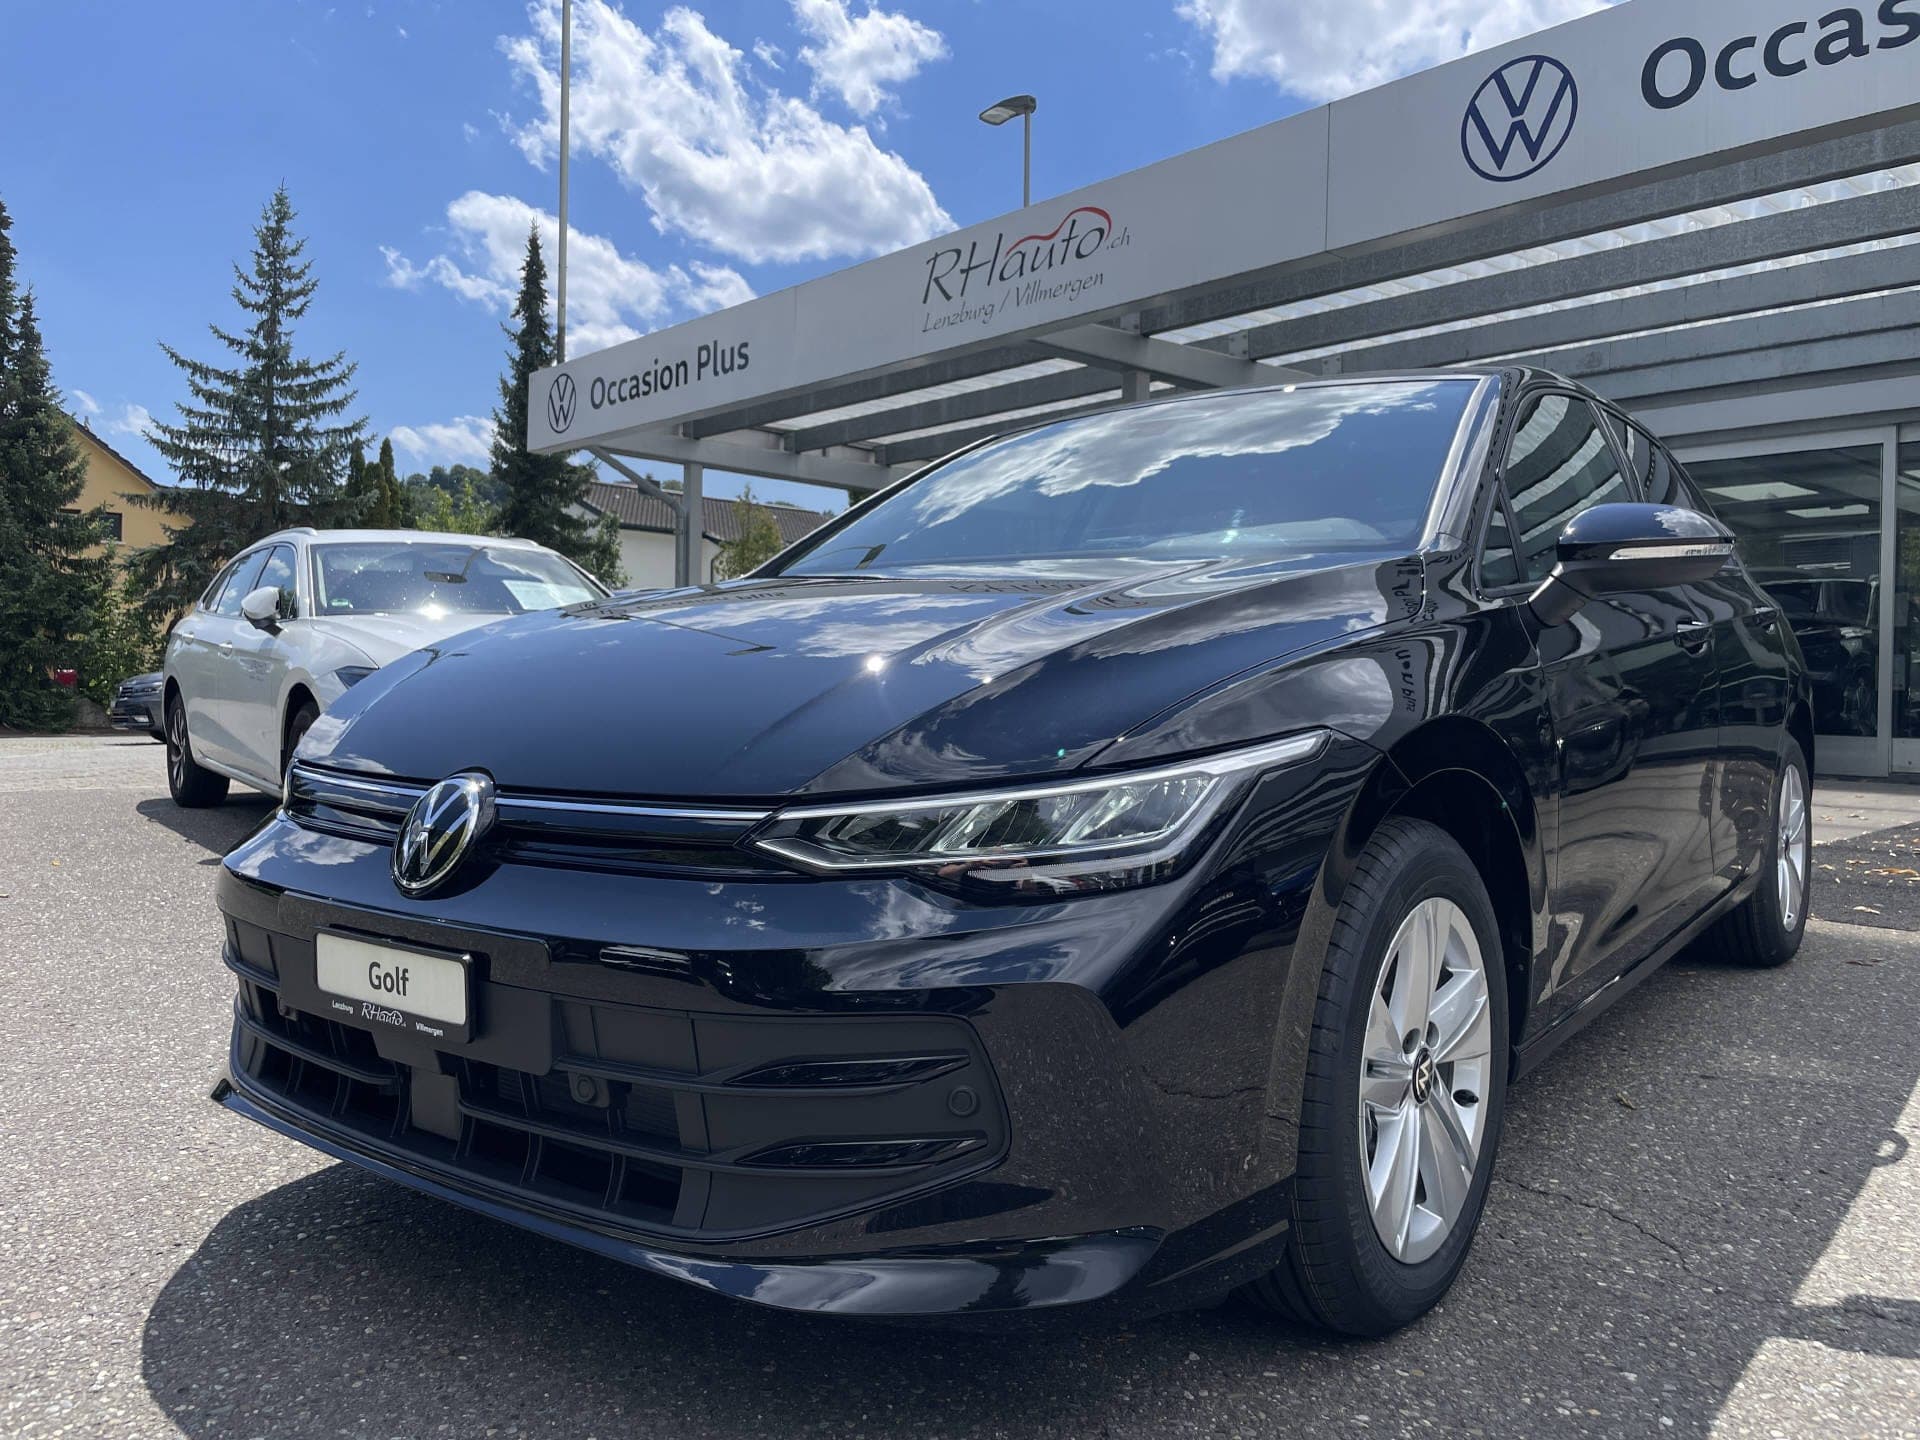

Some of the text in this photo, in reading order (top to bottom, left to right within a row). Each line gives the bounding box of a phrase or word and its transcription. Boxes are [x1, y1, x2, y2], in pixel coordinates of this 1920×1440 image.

[1640, 0, 1920, 110] Occas
[922, 301, 995, 333] Lenzburg
[1016, 272, 1104, 307] Villmergen
[590, 339, 750, 410] Occasion Plus
[368, 961, 409, 997] Golf
